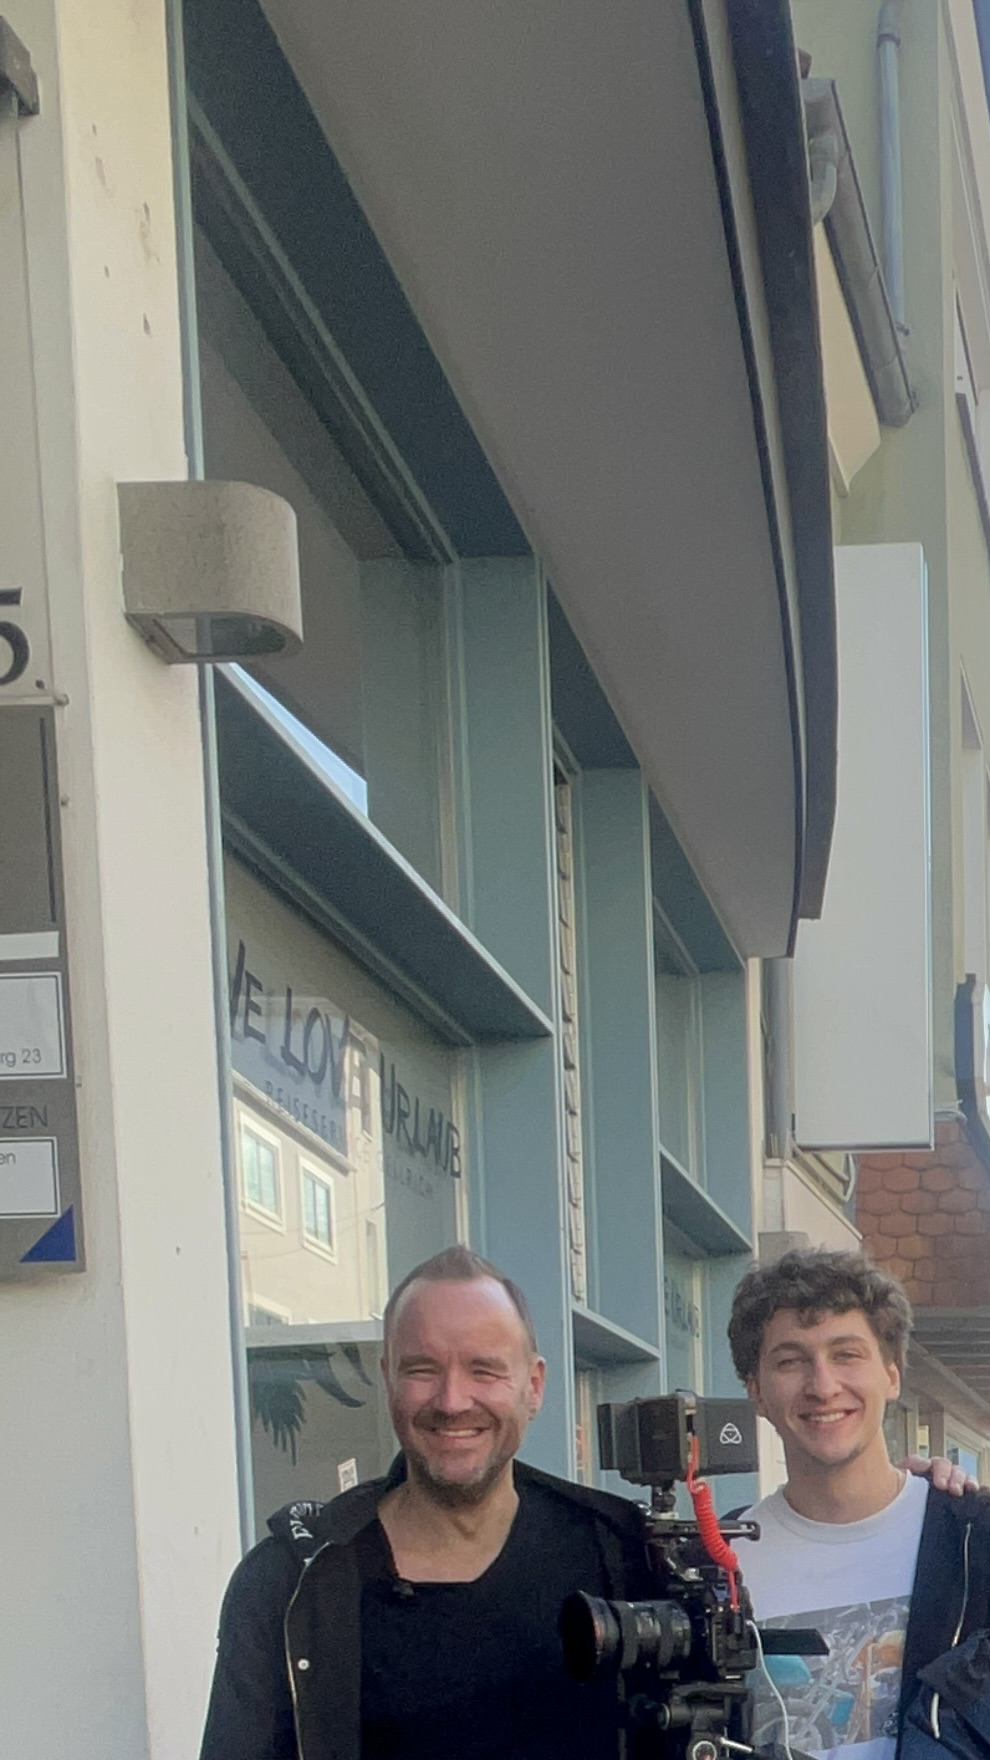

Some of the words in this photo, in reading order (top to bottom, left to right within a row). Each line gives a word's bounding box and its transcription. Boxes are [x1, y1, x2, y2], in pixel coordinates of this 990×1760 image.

[22, 1048, 42, 1064] 23
[281, 985, 370, 1118] LOVE
[380, 1051, 462, 1179] URLAUB
